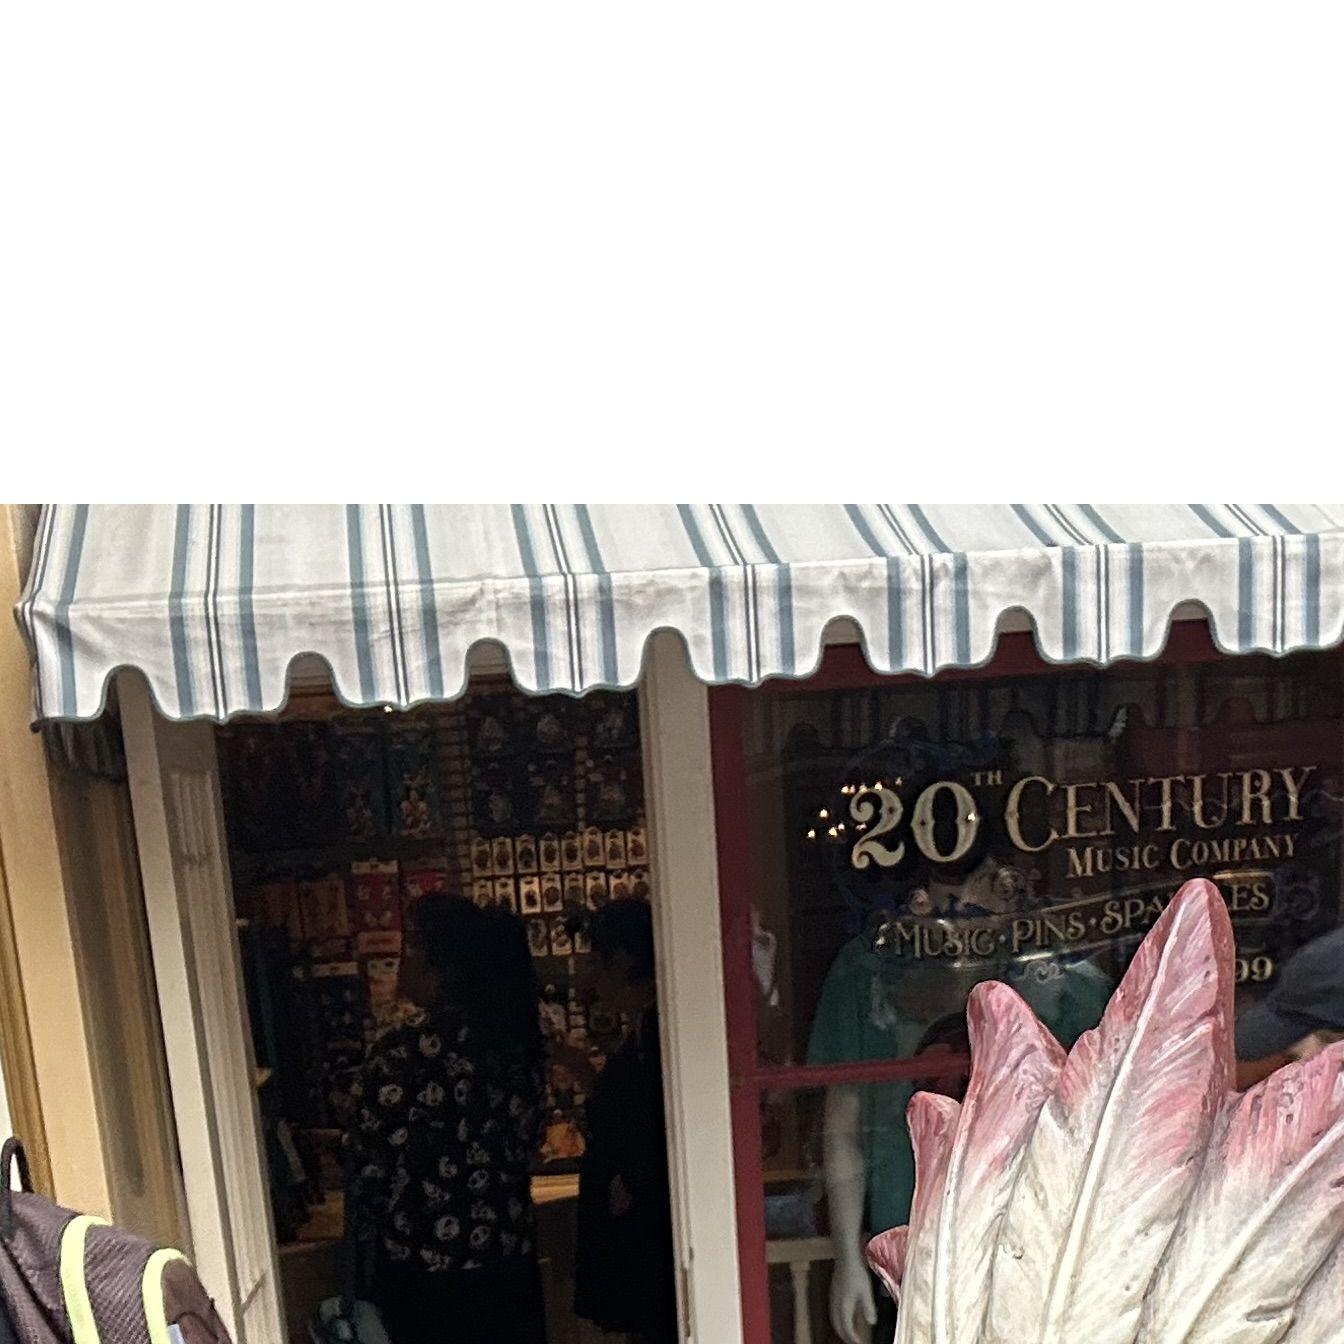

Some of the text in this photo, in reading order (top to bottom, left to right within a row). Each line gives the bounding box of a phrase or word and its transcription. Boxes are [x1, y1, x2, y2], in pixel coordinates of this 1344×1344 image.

[1004, 765, 1318, 852] CENTURY
[1066, 834, 1297, 878] MUSIC COMPANY
[893, 883, 1270, 959] MUSIC PINS SPAES
